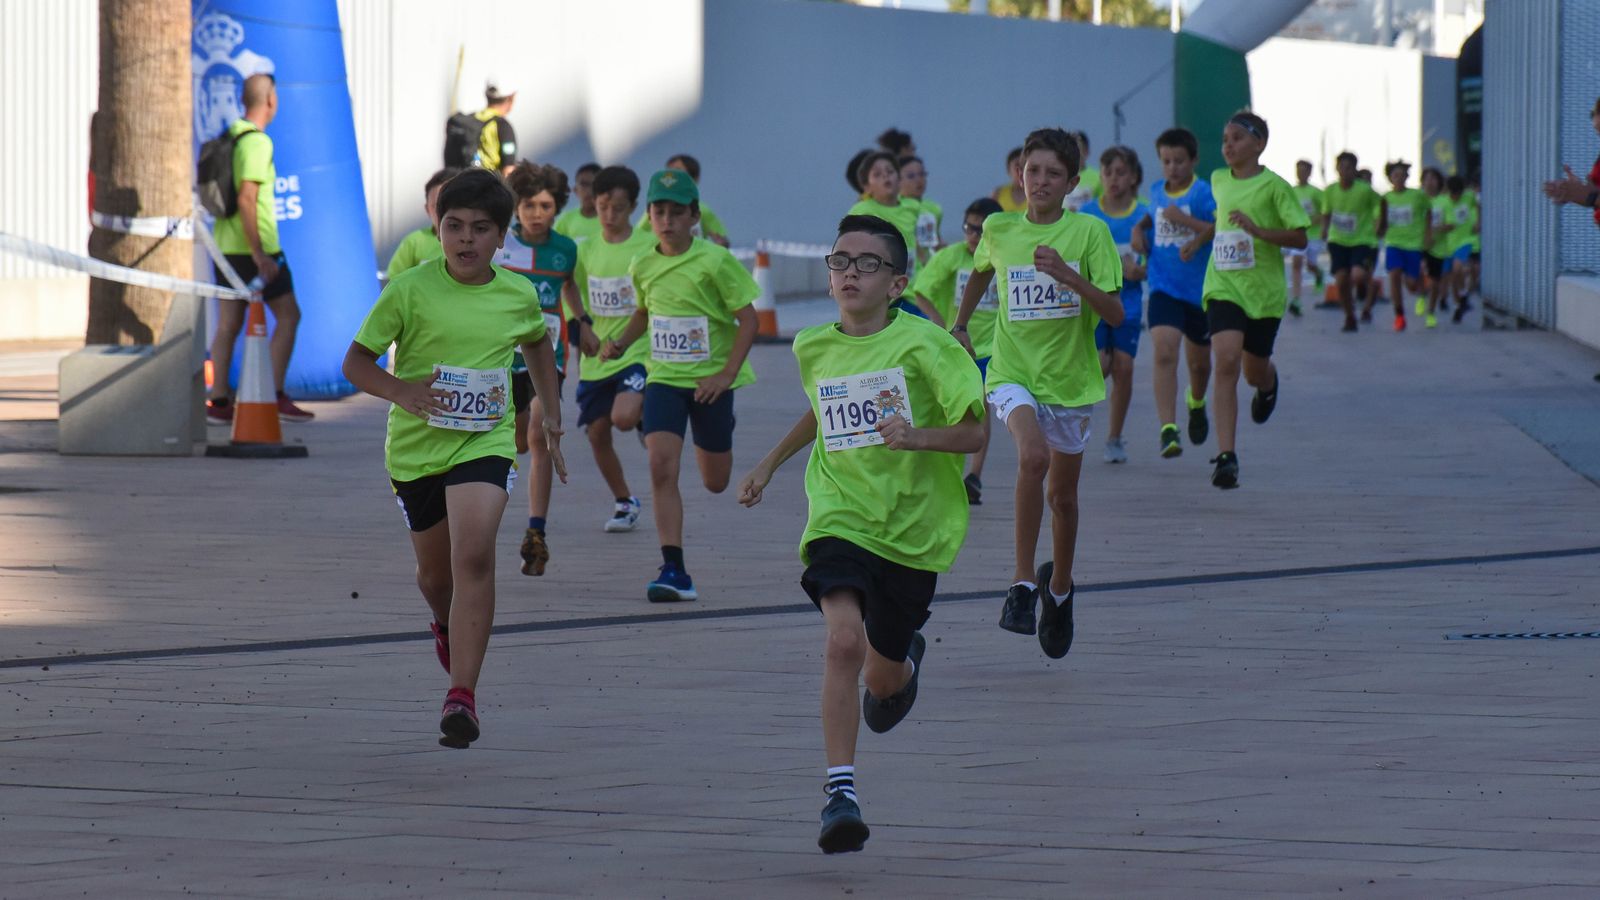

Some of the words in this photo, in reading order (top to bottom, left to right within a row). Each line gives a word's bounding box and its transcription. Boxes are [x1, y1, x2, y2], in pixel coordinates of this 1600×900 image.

[275, 175, 300, 193] DE
[1215, 246, 1236, 259] 1152
[591, 291, 619, 306] 1128
[1012, 284, 1056, 305] 1124
[654, 332, 688, 350] 1192
[860, 375, 888, 385] ALBERTO
[820, 385, 833, 397] XXI
[825, 400, 878, 430] 1196
